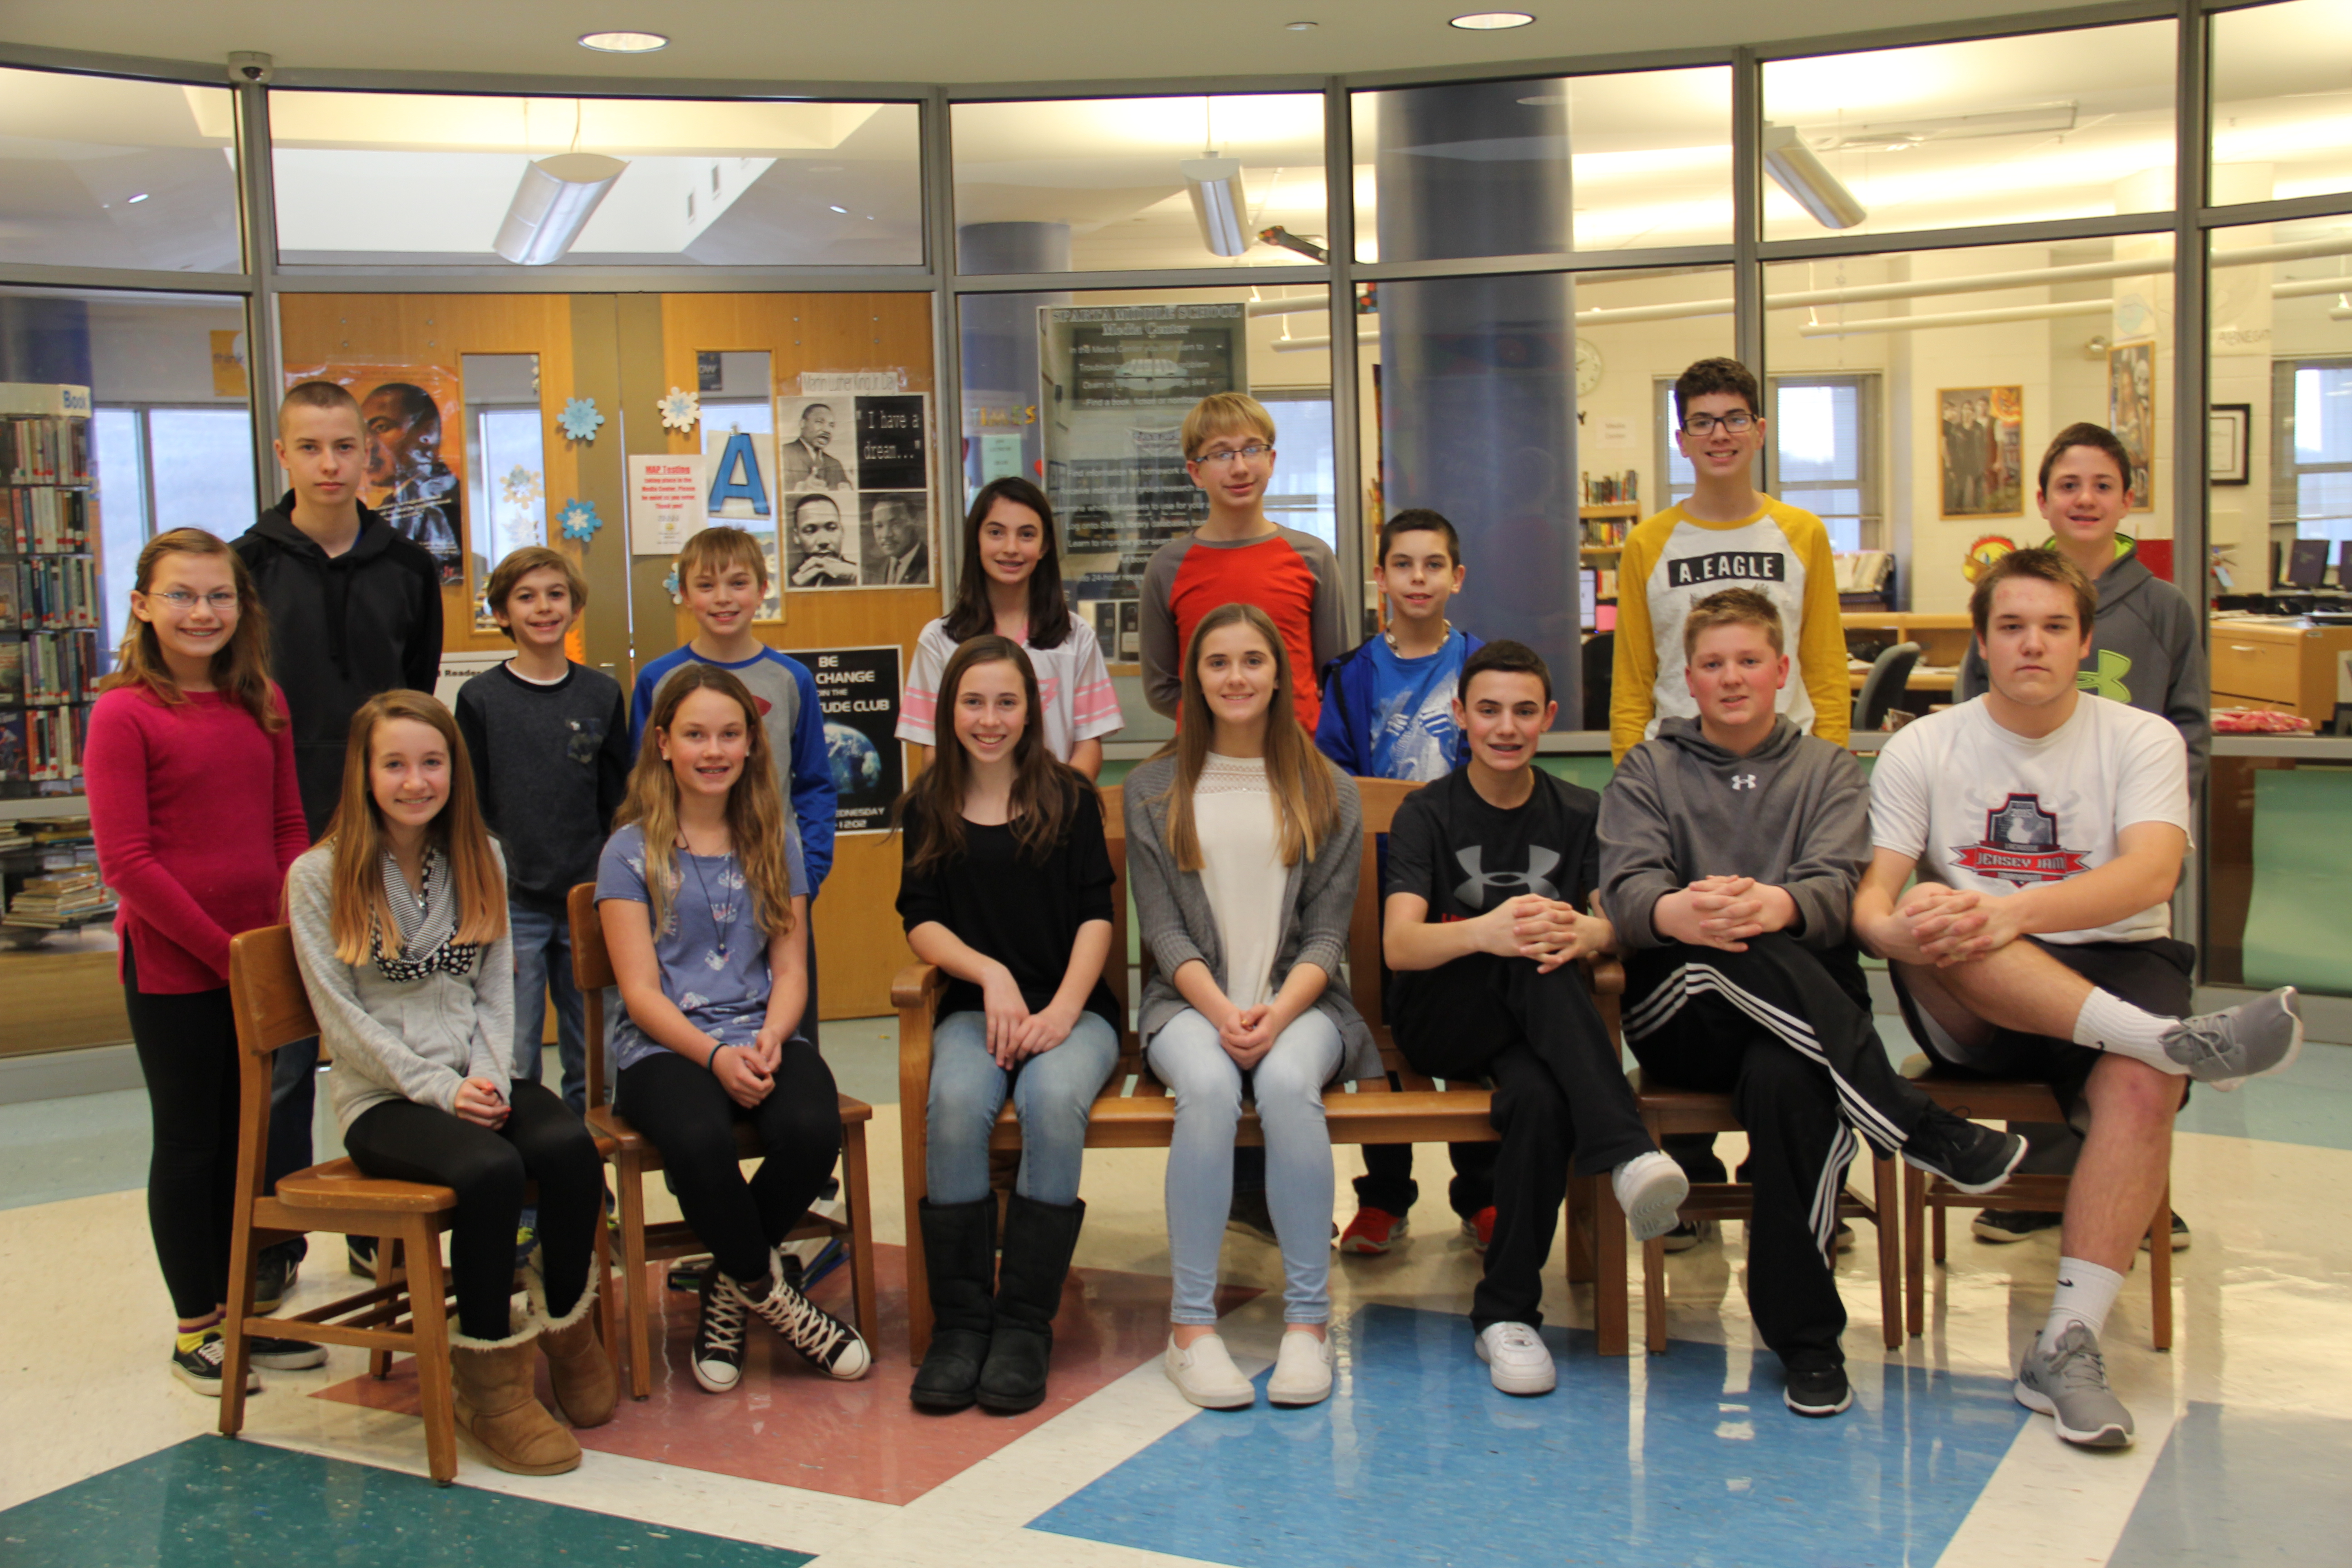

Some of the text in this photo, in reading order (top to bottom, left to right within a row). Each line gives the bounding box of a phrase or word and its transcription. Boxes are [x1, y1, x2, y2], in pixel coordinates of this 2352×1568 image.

[1052, 305, 1242, 323] SPARTA MIDDLE SCHOOL
[1102, 323, 1190, 336] Media Center
[880, 410, 906, 428] have
[912, 414, 919, 428] a
[646, 466, 691, 475] MAP Testing
[708, 433, 770, 516] A
[818, 655, 838, 668] BE
[816, 670, 875, 684] CHANGE
[832, 687, 848, 696] THE
[853, 698, 890, 712] CLUB
[835, 806, 885, 818] EDNESDAY
[1976, 853, 2067, 870] JERSEY JAM
